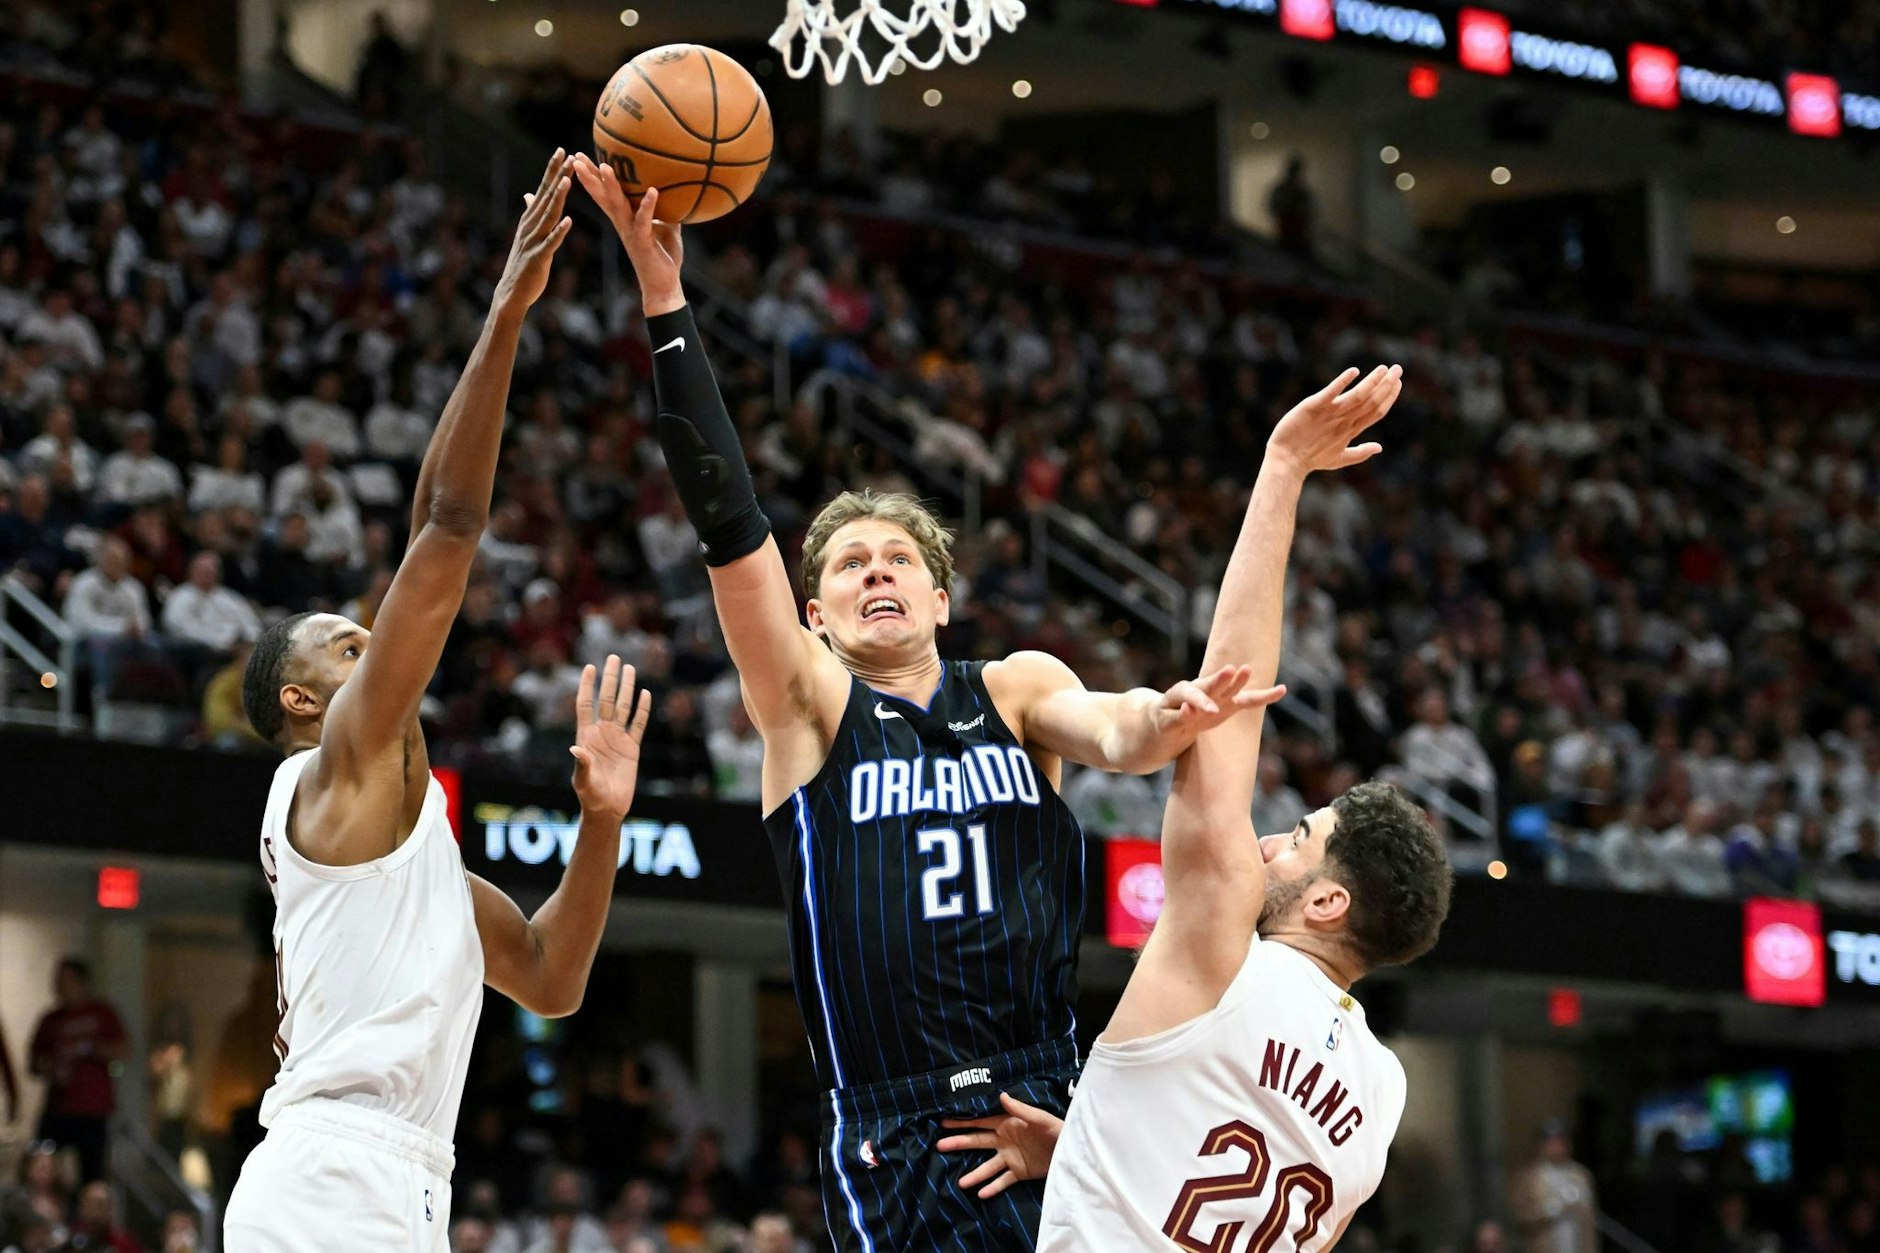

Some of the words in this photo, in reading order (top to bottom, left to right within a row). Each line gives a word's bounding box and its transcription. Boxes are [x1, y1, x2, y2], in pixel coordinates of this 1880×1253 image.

[1510, 30, 1618, 83] TOYOTA
[1678, 65, 1785, 116] TOYOTA
[850, 745, 1041, 824] ORLANDO
[916, 823, 994, 921] 21
[949, 1067, 992, 1092] MAGIC
[1258, 1038, 1363, 1147] NIANG
[1162, 1119, 1334, 1253] 20
